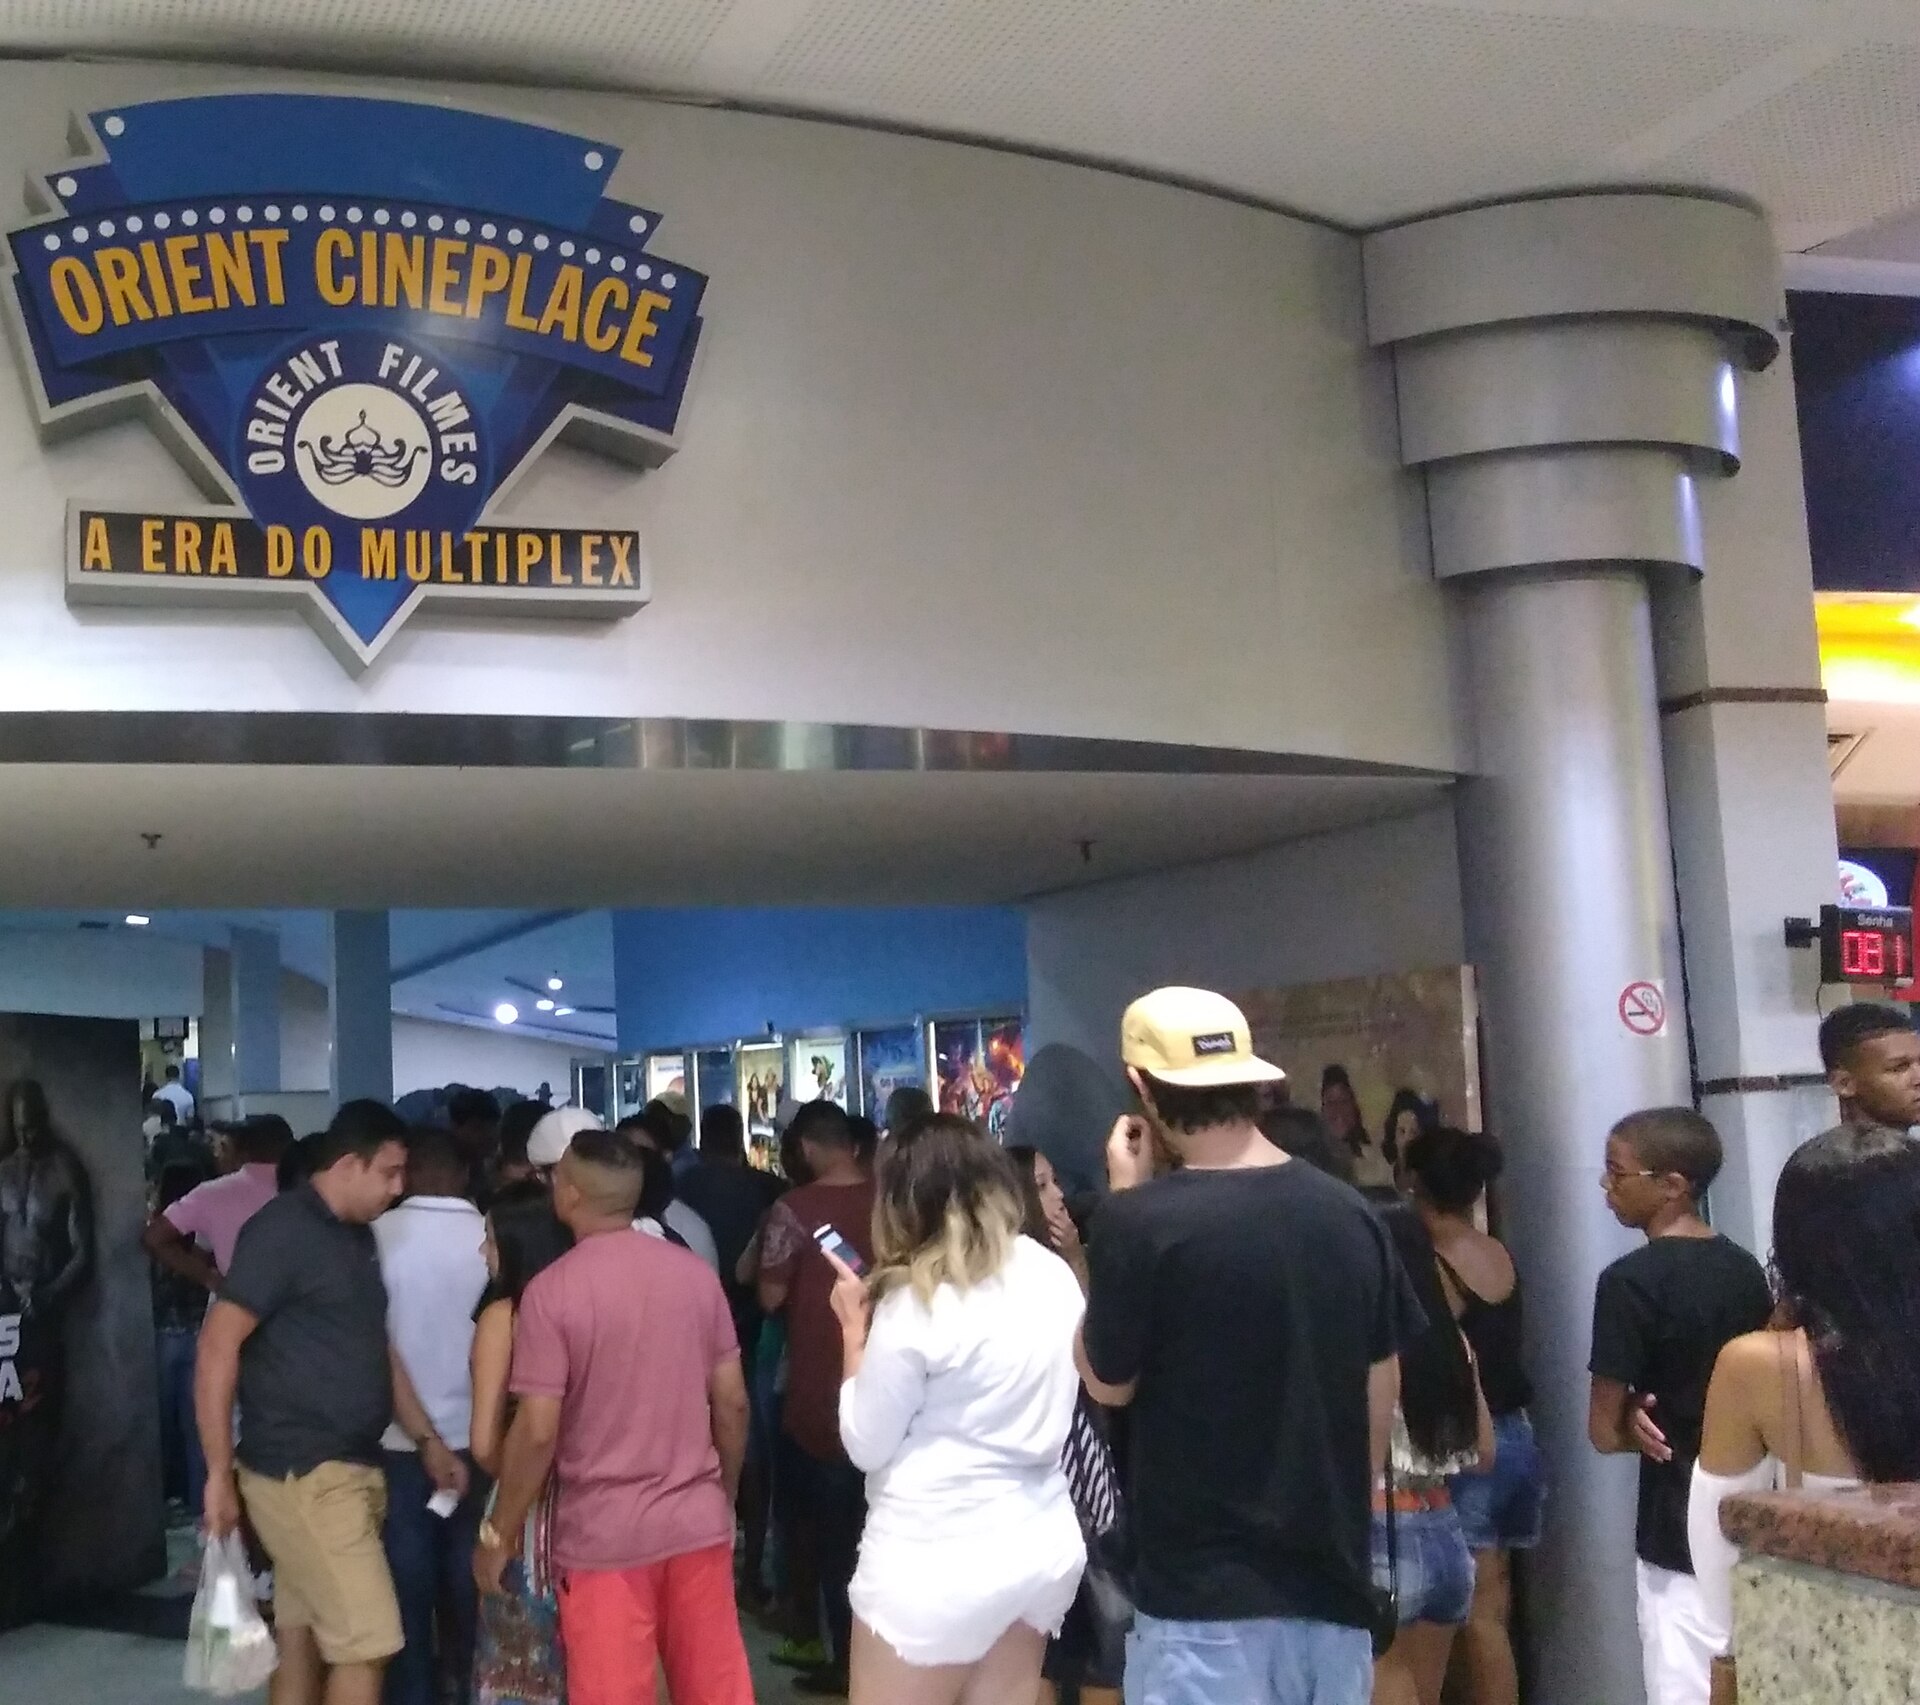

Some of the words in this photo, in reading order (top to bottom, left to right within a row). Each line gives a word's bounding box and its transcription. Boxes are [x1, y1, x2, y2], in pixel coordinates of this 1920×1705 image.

[50, 229, 289, 335] ORIENT
[315, 228, 671, 367] CINEPLACE
[247, 340, 343, 476] ORIENT
[378, 342, 478, 486] FILMES
[83, 517, 112, 570] A
[141, 519, 238, 574] ERA
[266, 525, 333, 578] DO
[361, 528, 637, 586] MULTIPLEX
[1857, 913, 1894, 927] Senha
